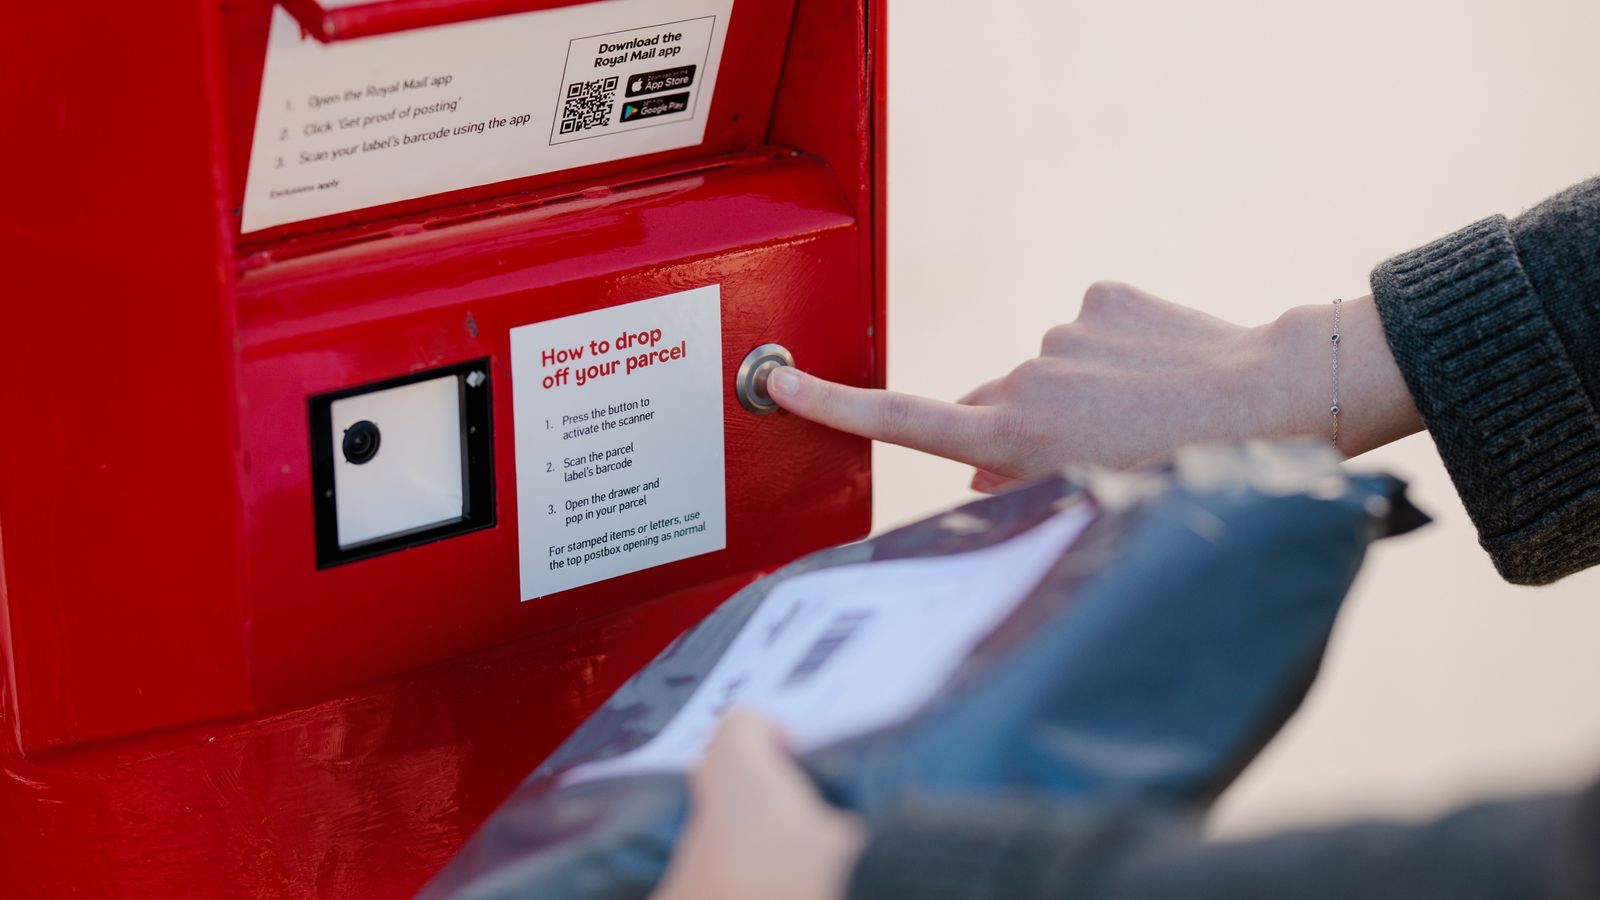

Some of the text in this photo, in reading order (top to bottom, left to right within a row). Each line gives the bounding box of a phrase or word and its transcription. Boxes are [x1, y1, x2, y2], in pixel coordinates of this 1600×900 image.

[594, 46, 681, 68] Royal Mail app
[598, 32, 682, 54] Download the
[308, 94, 340, 108] Open
[343, 90, 363, 101] the
[366, 80, 400, 97] Royal
[402, 76, 428, 91] Mail
[430, 74, 453, 87] app
[645, 80, 665, 91] App
[666, 75, 690, 87] Store
[303, 122, 333, 137] Click
[362, 108, 397, 129] proof
[398, 106, 411, 119] of
[640, 103, 668, 116] Google
[668, 101, 685, 112] Play
[298, 150, 329, 164] Scan
[331, 145, 360, 161] your
[362, 135, 400, 152] label's
[403, 127, 451, 145] barcode
[453, 122, 485, 134] using
[488, 117, 507, 129] the
[509, 113, 531, 126] app
[318, 180, 340, 190] apply
[541, 328, 662, 367] How to drop
[542, 340, 686, 389] off your parcel
[545, 397, 650, 430] 1. Press the button to
[562, 410, 655, 440] activate the scanner
[546, 442, 634, 473] 2. Scan the parcel
[564, 457, 633, 482] label's barcode
[547, 477, 660, 515] 3. Open the drawer and
[565, 495, 647, 527] pop in your parcel
[549, 511, 701, 557] For stamped items or letters, use
[549, 521, 706, 571] the top postbox opening as normal
